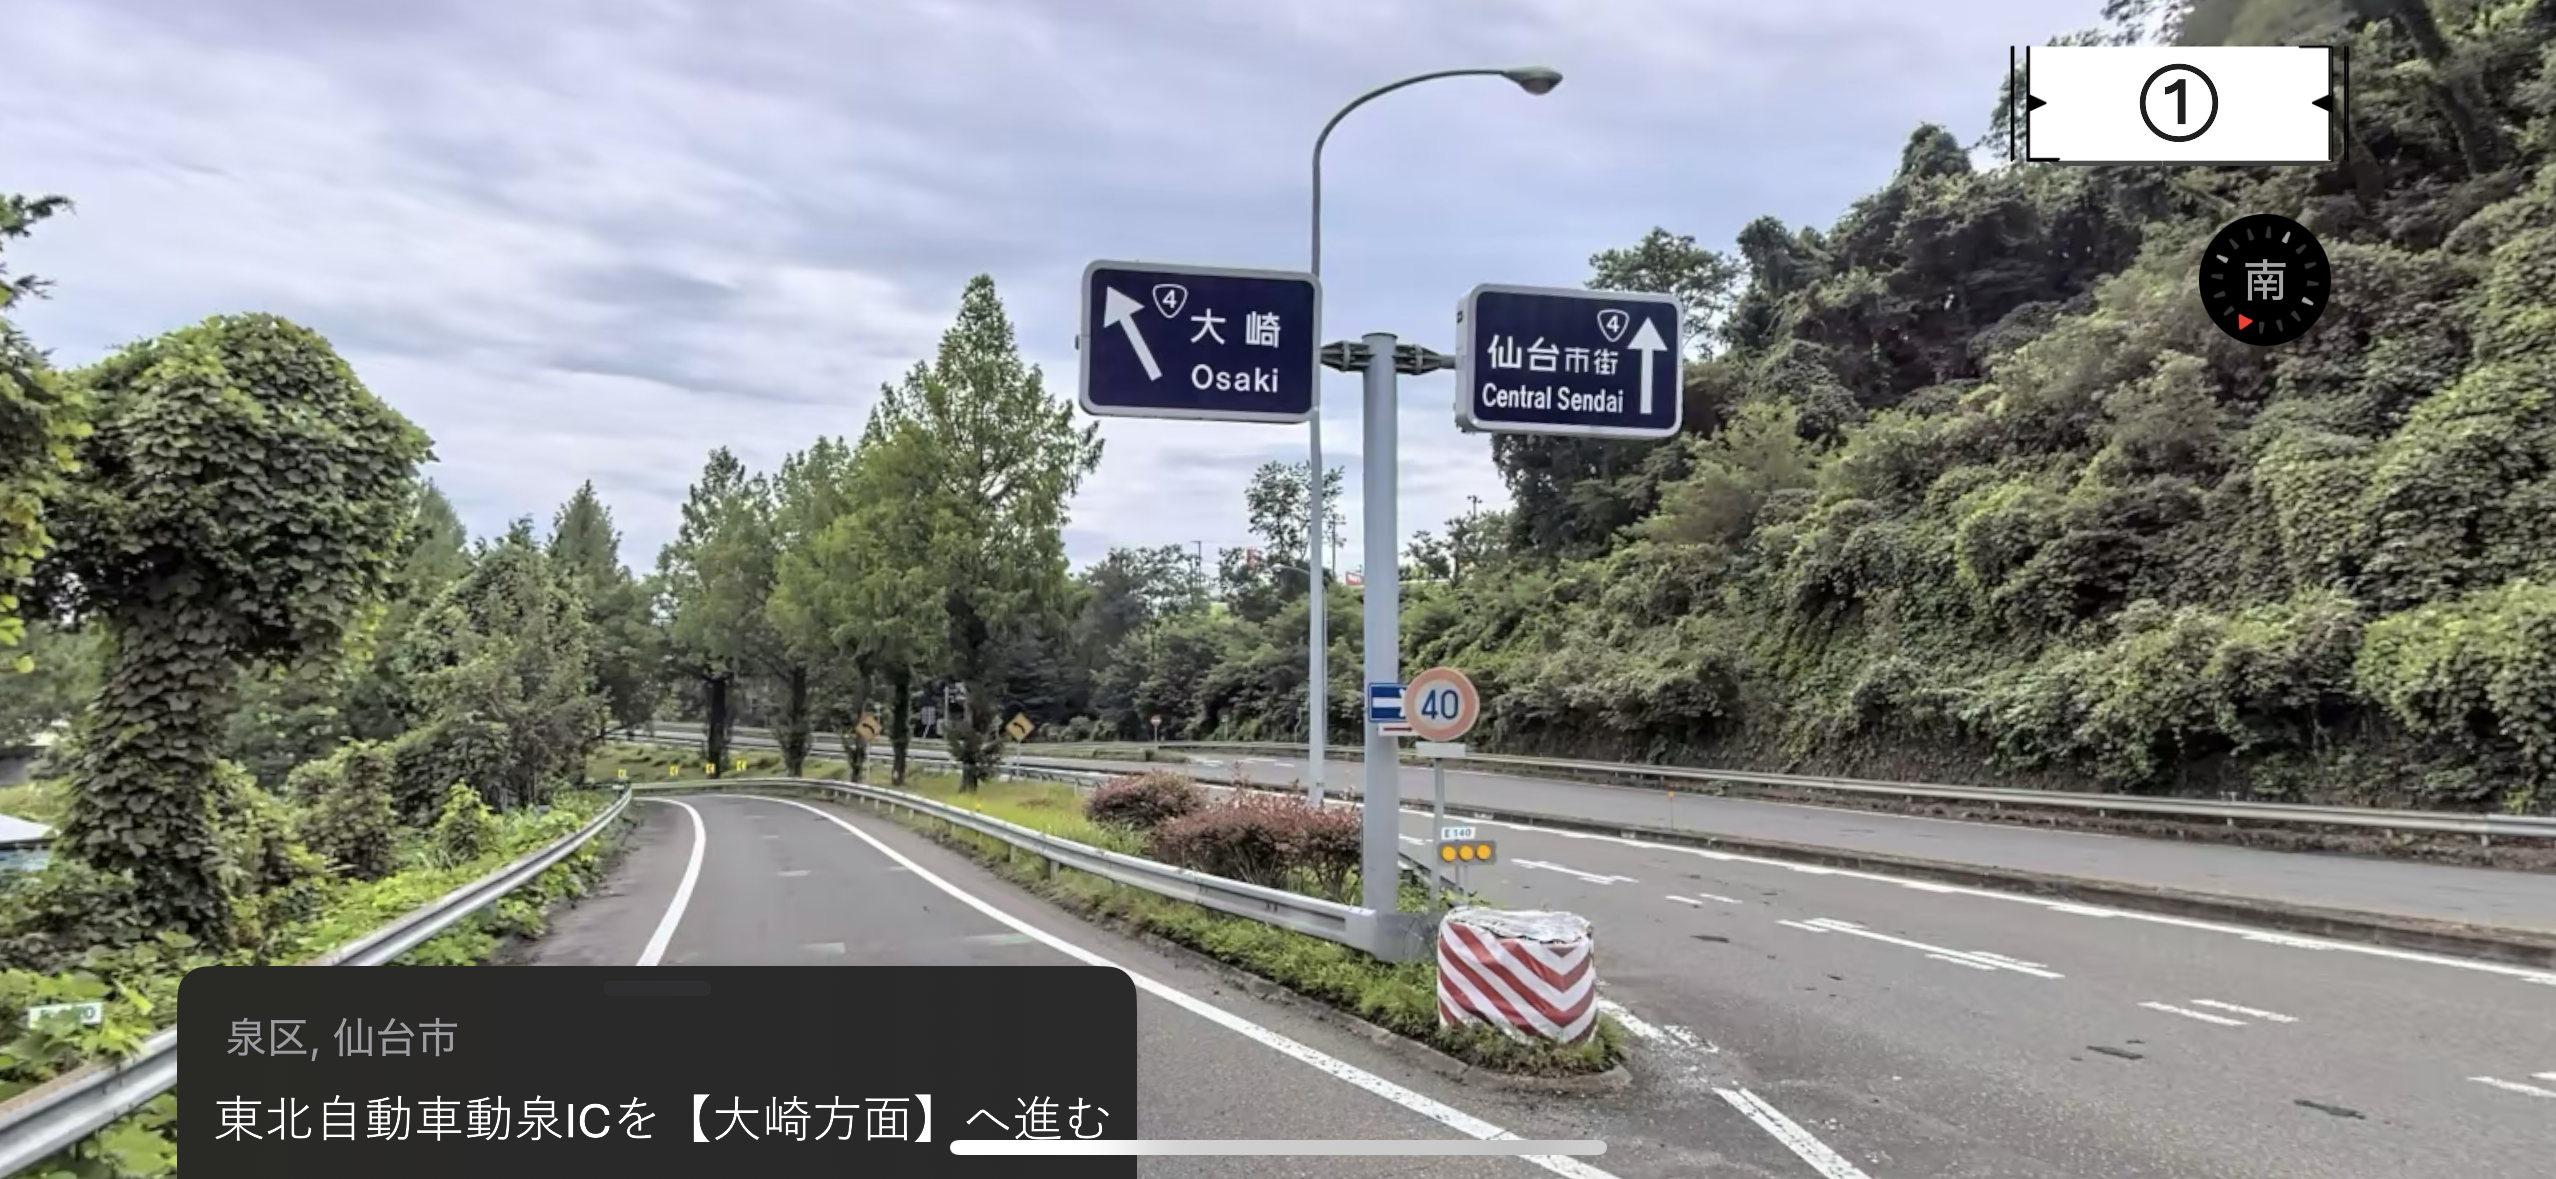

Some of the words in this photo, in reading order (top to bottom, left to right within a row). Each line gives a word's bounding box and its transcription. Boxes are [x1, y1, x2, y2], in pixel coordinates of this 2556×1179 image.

[1162, 289, 1178, 309] 4
[1190, 308, 1281, 348] 大崎
[1606, 314, 1620, 333] 4
[1487, 334, 1619, 375] 仙台市街
[1191, 363, 1279, 393] Osaki
[1482, 382, 1552, 410] Central
[1557, 386, 1624, 413] Sendai
[1421, 689, 1459, 720] 40
